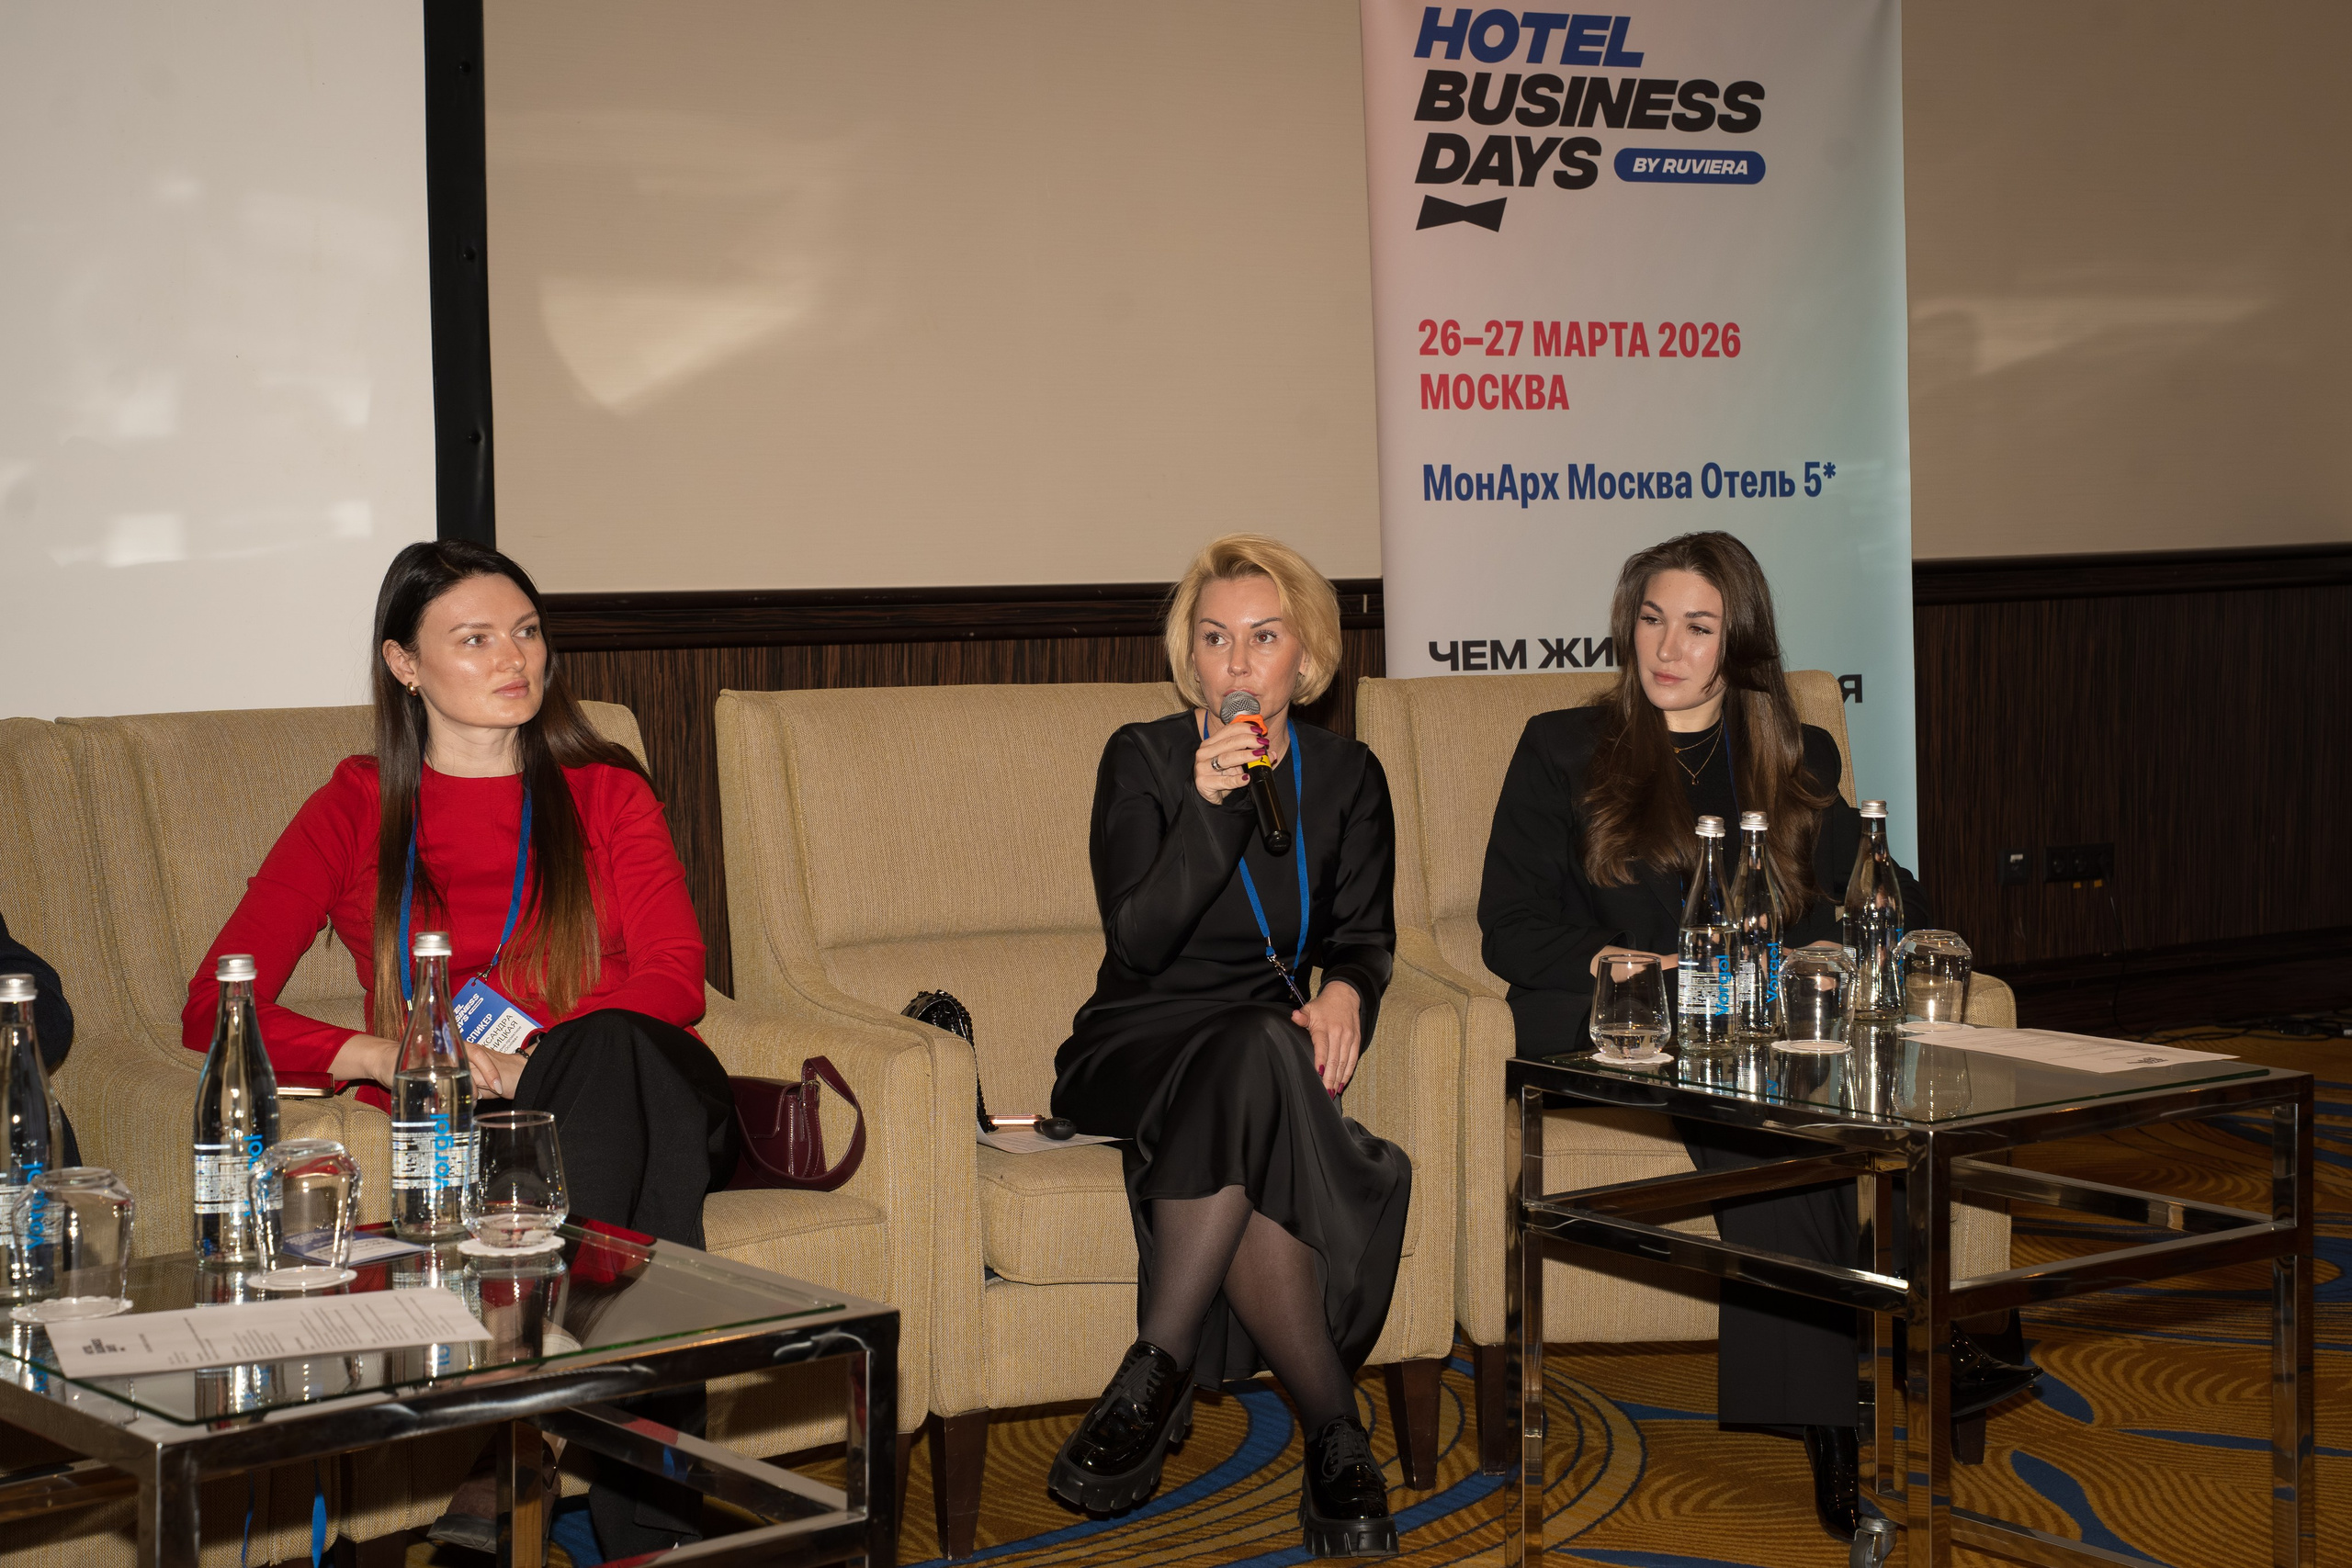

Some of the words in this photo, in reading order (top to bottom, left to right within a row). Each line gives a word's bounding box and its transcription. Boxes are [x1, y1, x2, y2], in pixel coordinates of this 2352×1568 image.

[1413, 6, 1645, 69] HOTEL
[1413, 69, 1766, 134] BUSINESS
[1415, 131, 1602, 191] DAYS
[1632, 157, 1659, 174] BY
[1662, 158, 1749, 175] RUVIERA
[1532, 320, 1651, 358] МАРТА
[1657, 321, 1742, 359] 2026
[1419, 373, 1570, 411] МОСКВА
[1422, 463, 1560, 509] МонАрх
[1567, 462, 1693, 501] Москва
[1700, 461, 1795, 499] Отель
[1428, 638, 1528, 672] ЧЕМ
[1536, 636, 1624, 669] ЖИ
[1714, 954, 1733, 1017] Vorgol
[455, 993, 480, 1023] SINESS
[457, 1014, 469, 1030] AYS
[466, 1013, 493, 1043] СПИКЕР
[481, 1013, 514, 1047] КСАНДРА
[490, 1020, 518, 1051] НИЦКАЯ
[429, 1113, 455, 1191] Vorgol
